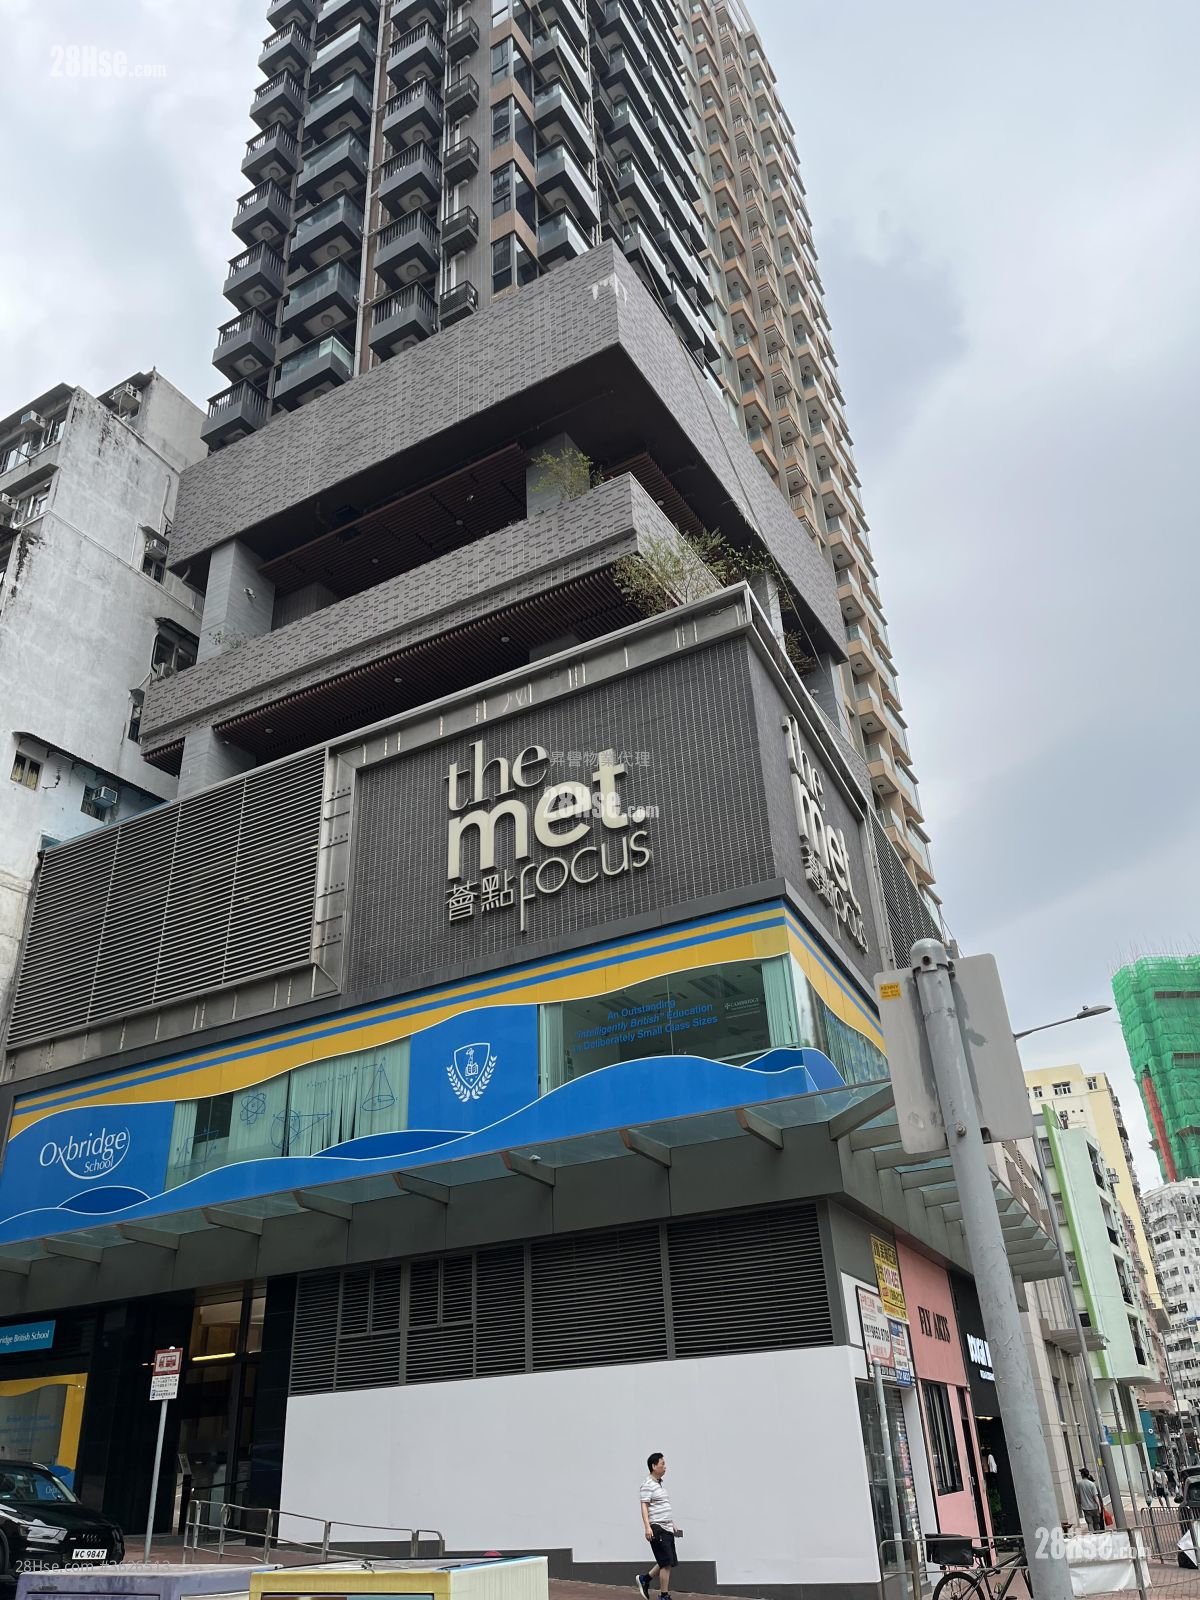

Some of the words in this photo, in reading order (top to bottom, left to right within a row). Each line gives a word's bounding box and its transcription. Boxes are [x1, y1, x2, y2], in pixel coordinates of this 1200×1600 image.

[443, 739, 550, 812] the
[446, 868, 515, 921] 薈點
[518, 830, 652, 933] focus
[608, 1010, 618, 1021] An
[622, 999, 676, 1017] Outstanding
[667, 1003, 713, 1019] Education
[584, 1032, 635, 1050] Deliberately
[638, 1025, 662, 1040] Small
[666, 1021, 690, 1034] Class
[693, 1015, 718, 1028] Sizes
[40, 1127, 127, 1167] Oxbridge
[84, 1156, 113, 1174] School
[14, 1332, 30, 1342] British
[31, 1329, 50, 1340] School
[74, 1550, 86, 1558] WC
[86, 1550, 105, 1559] 9847
